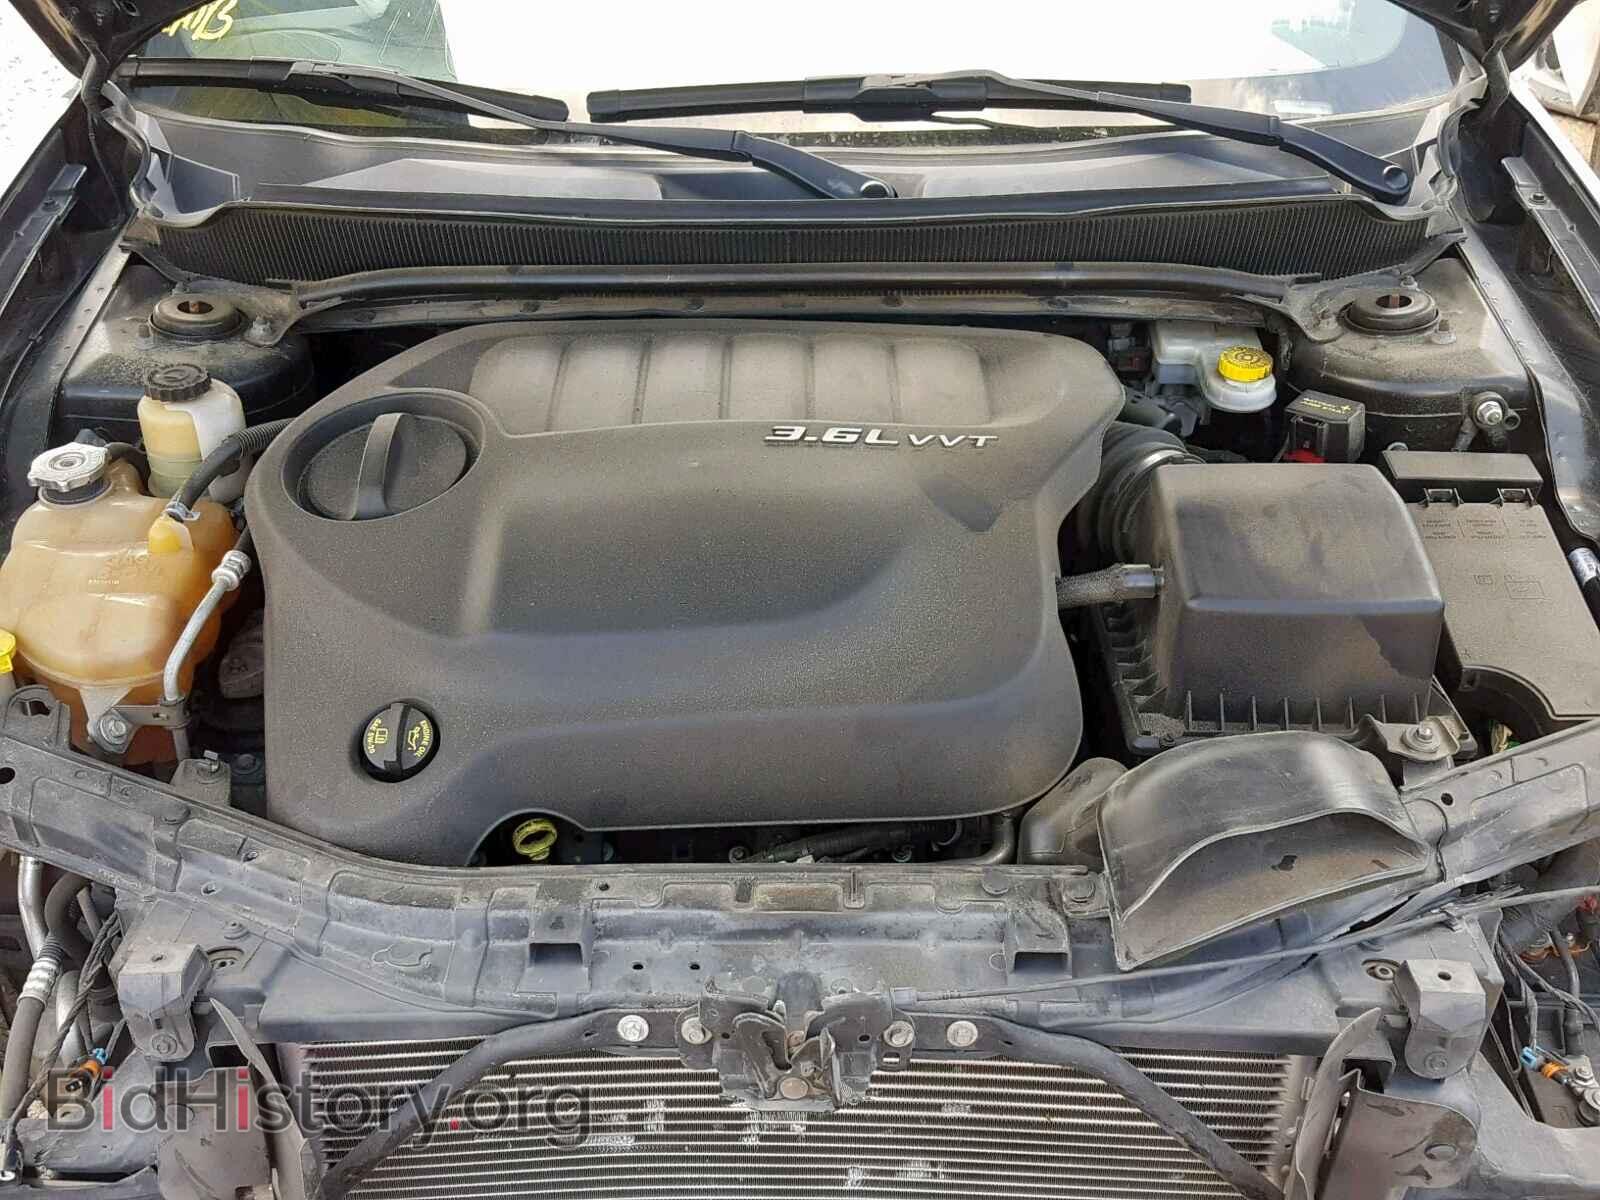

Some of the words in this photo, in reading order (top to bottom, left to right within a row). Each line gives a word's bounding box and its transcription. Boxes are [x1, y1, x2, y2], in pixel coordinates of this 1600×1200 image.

[764, 425, 900, 446] 3.6L
[908, 433, 998, 448] VVT
[420, 720, 432, 746] ENGINE
[413, 746, 426, 758] OIL
